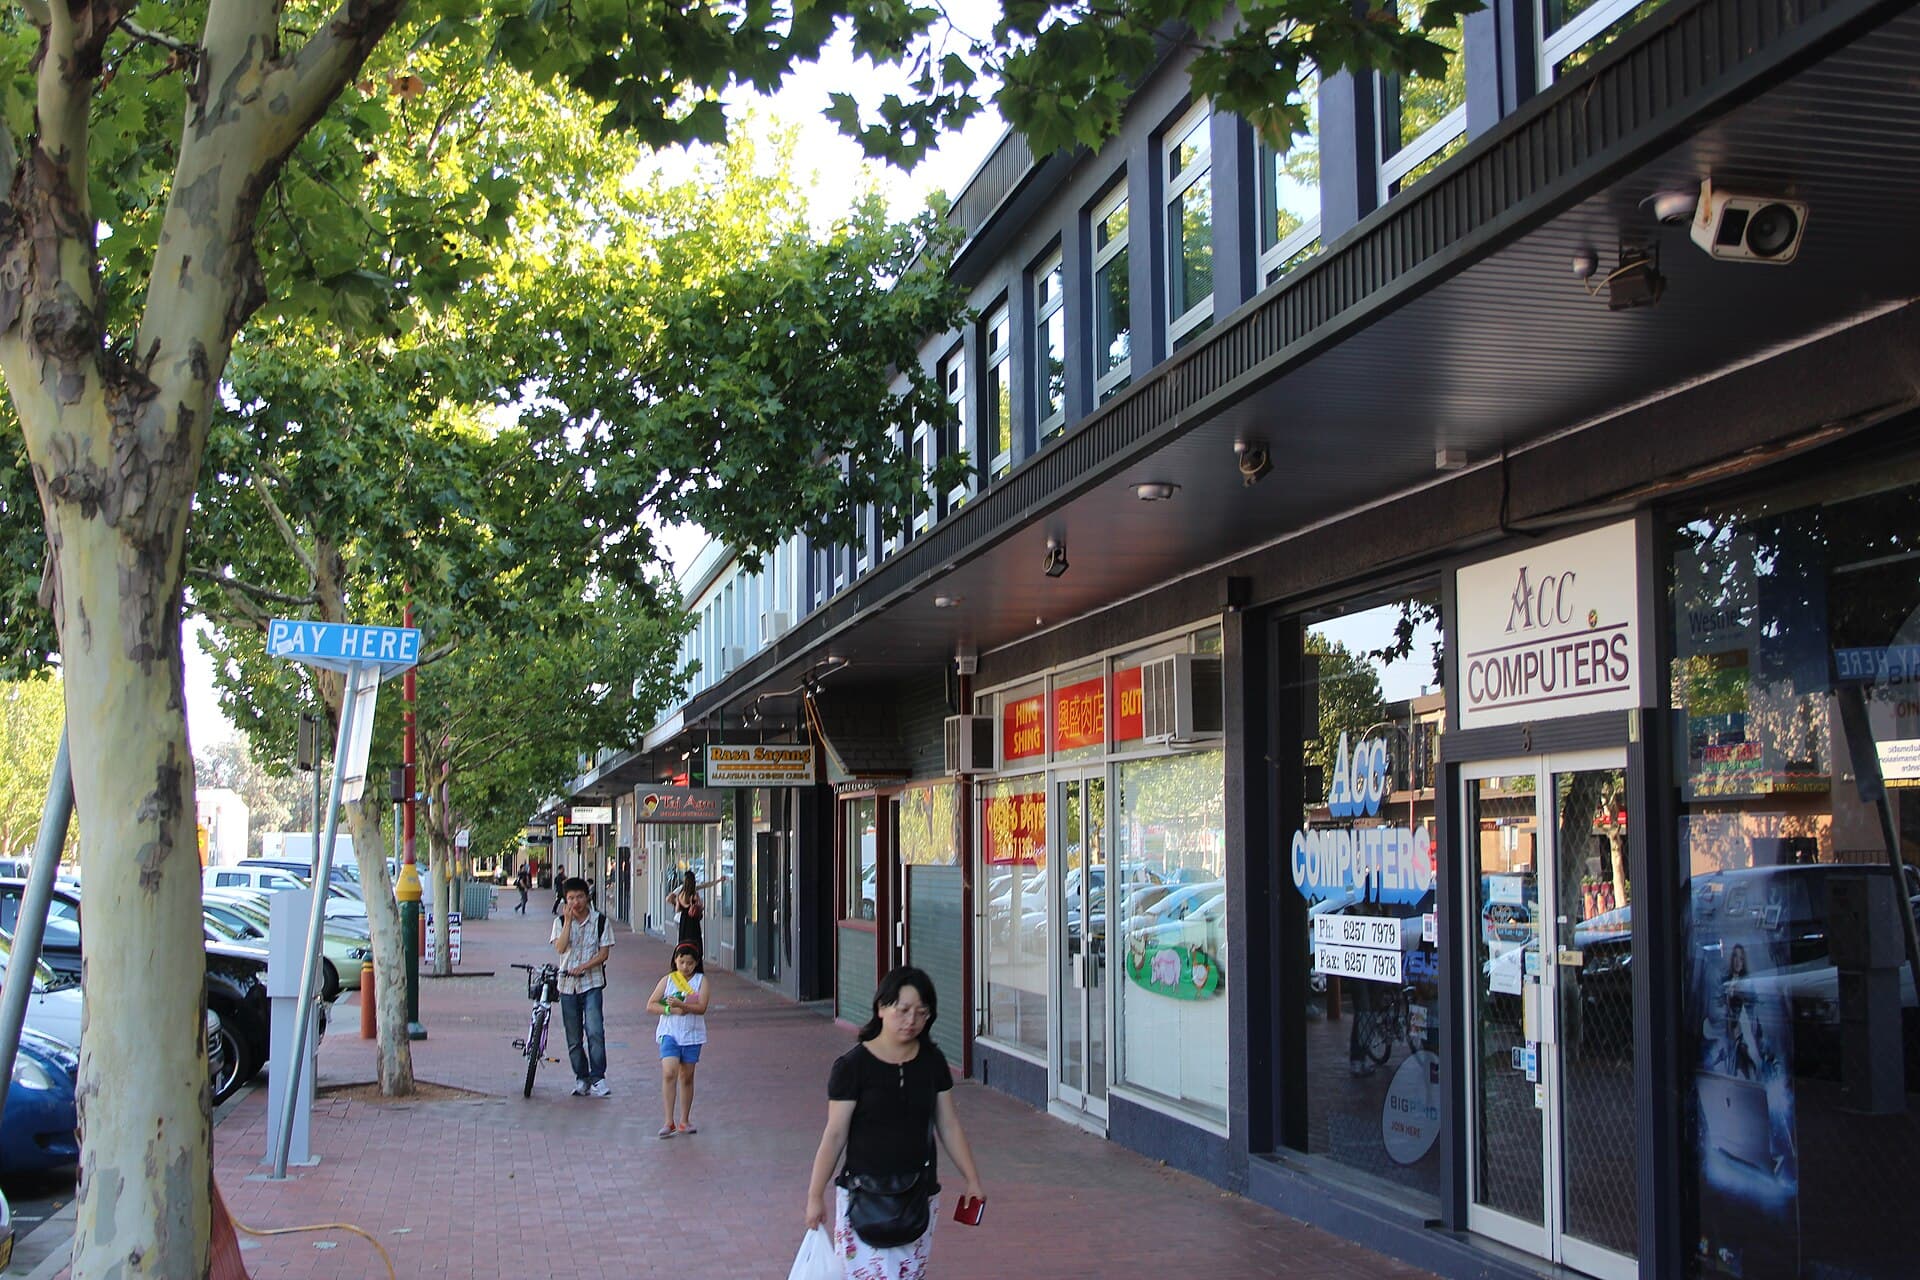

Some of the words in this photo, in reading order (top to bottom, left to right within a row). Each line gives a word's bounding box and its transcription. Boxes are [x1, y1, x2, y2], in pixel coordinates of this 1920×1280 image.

[1689, 608, 1744, 635] Westne
[272, 623, 328, 653] PAY
[340, 628, 416, 660] HERE
[1468, 633, 1629, 704] COMPUTERS
[1016, 699, 1039, 729] HING
[1058, 689, 1104, 741] 興盛肉店
[1014, 726, 1041, 755] SHING
[711, 747, 751, 761] Rasa
[754, 747, 811, 764] Sayang
[1292, 826, 1431, 902] COMPUTERS
[1318, 919, 1334, 939] Ph:
[1343, 920, 1366, 941] 6257
[1371, 922, 1396, 944] 7979
[1320, 949, 1340, 970] Fax:
[1344, 951, 1368, 973] 6257
[1373, 954, 1397, 977] 7978
